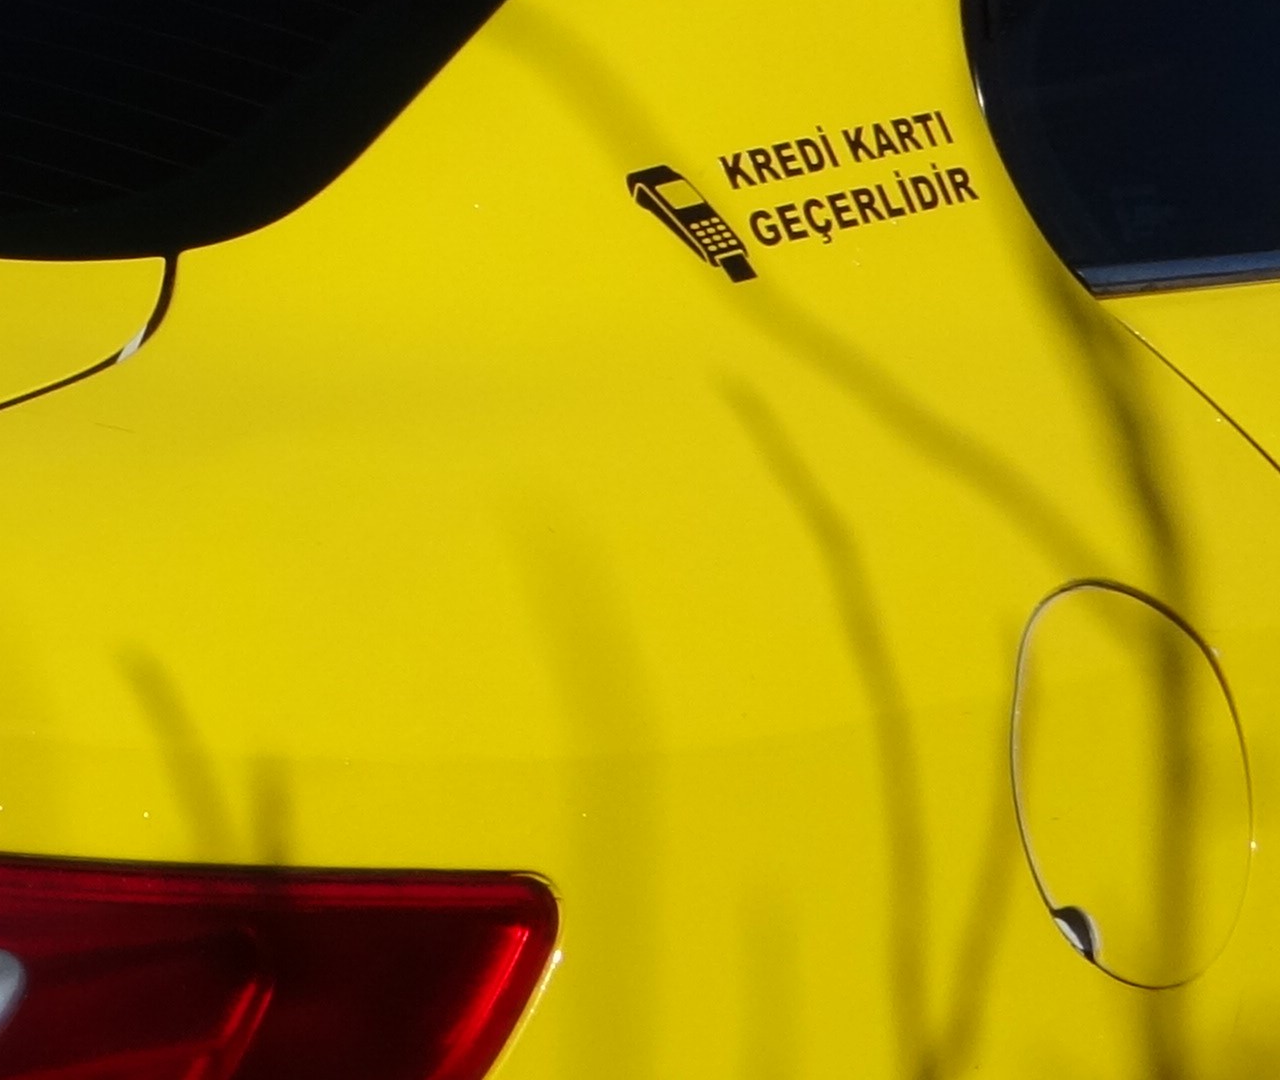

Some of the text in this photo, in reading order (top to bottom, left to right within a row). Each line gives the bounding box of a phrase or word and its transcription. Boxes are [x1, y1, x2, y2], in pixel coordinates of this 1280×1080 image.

[718, 110, 954, 190] KREDİ KARTI
[747, 162, 980, 246] GEÇERLİDİR
